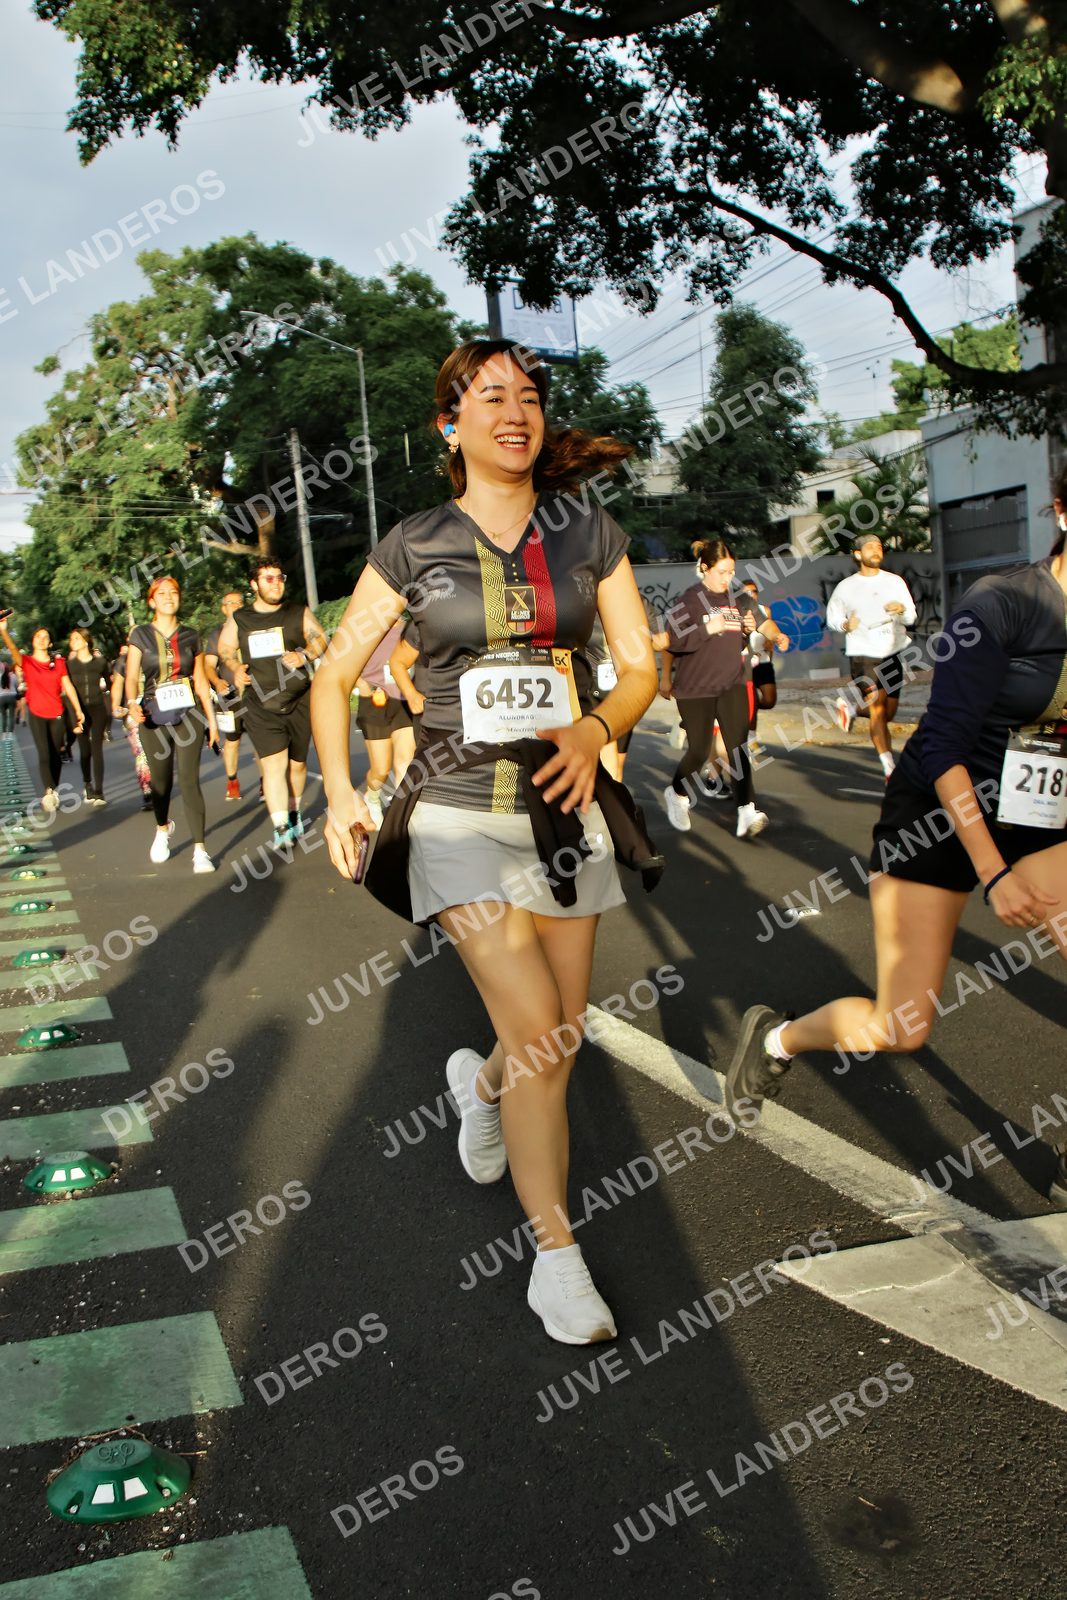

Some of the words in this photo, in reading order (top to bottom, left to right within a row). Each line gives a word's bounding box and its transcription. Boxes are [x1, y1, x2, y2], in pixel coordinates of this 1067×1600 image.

[554, 656, 567, 667] 5K
[476, 678, 554, 709] 6452
[1016, 764, 1067, 797] 218
